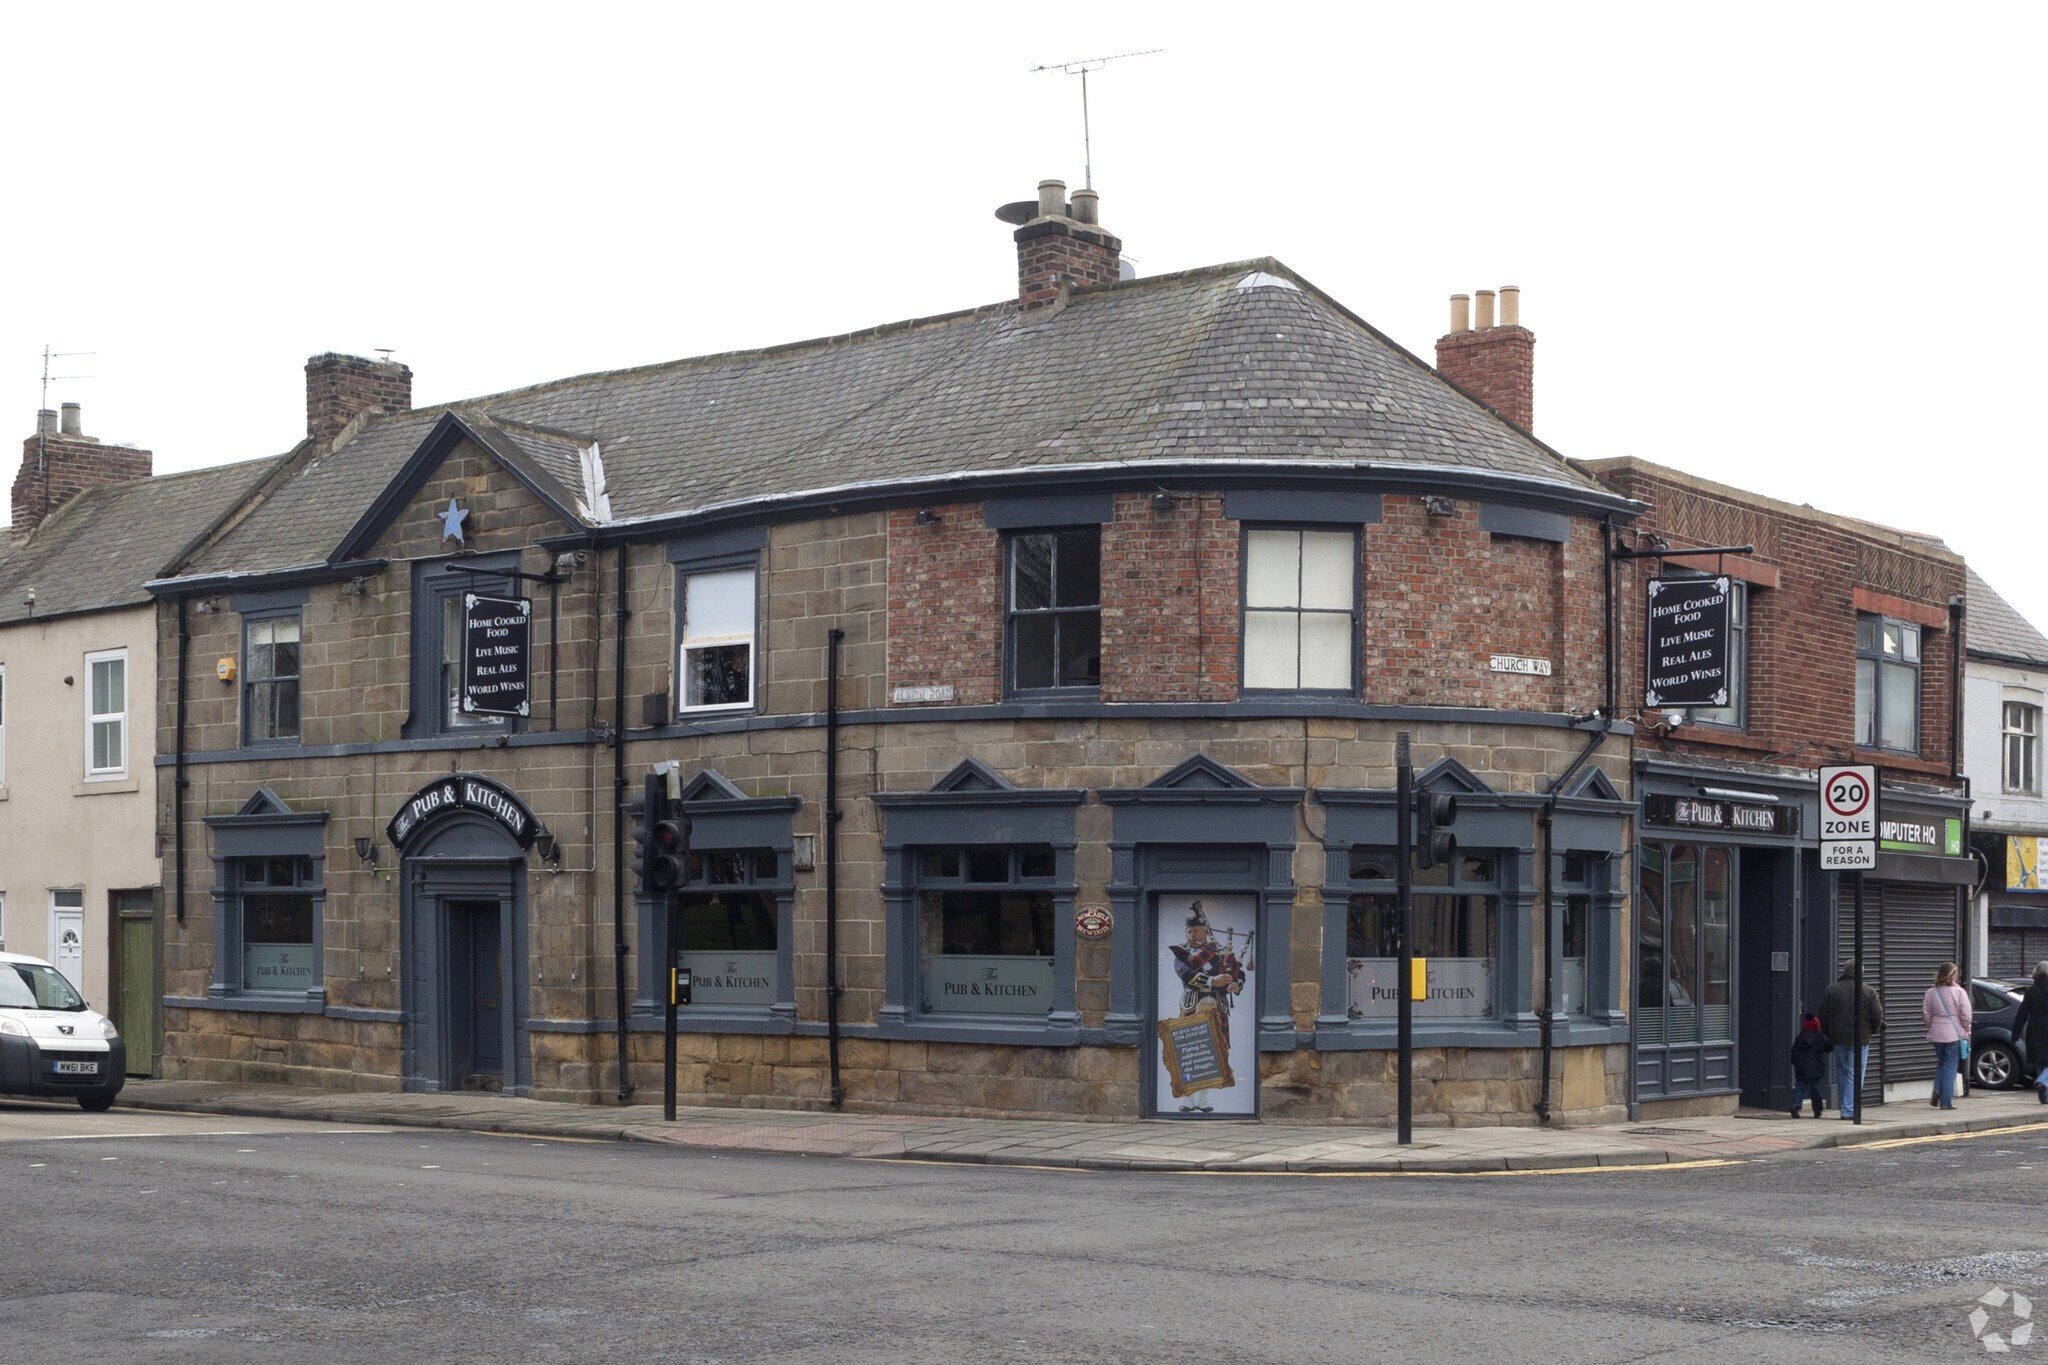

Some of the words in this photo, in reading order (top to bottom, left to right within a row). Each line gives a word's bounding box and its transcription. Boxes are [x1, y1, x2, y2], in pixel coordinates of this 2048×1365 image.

[1489, 658, 1528, 672] CHURCH
[1532, 661, 1550, 674] WAY
[1833, 784, 1864, 802] 20
[412, 791, 440, 819] PUB
[443, 785, 456, 803] &
[466, 783, 525, 832] KITCHEN
[1692, 803, 1712, 822] PUB
[1714, 805, 1722, 823] &
[1734, 806, 1775, 827] KITCHEN
[1826, 821, 1870, 833] ZONE
[1923, 826, 1936, 845] HQ
[1826, 856, 1870, 864] REASON
[981, 967, 998, 980] The
[714, 976, 722, 987] &
[944, 982, 967, 995] PUB
[971, 982, 980, 995] &
[985, 983, 1036, 996] KITCHEN
[1427, 988, 1475, 999] ITCHEN
[80, 1063, 95, 1072] BKE
